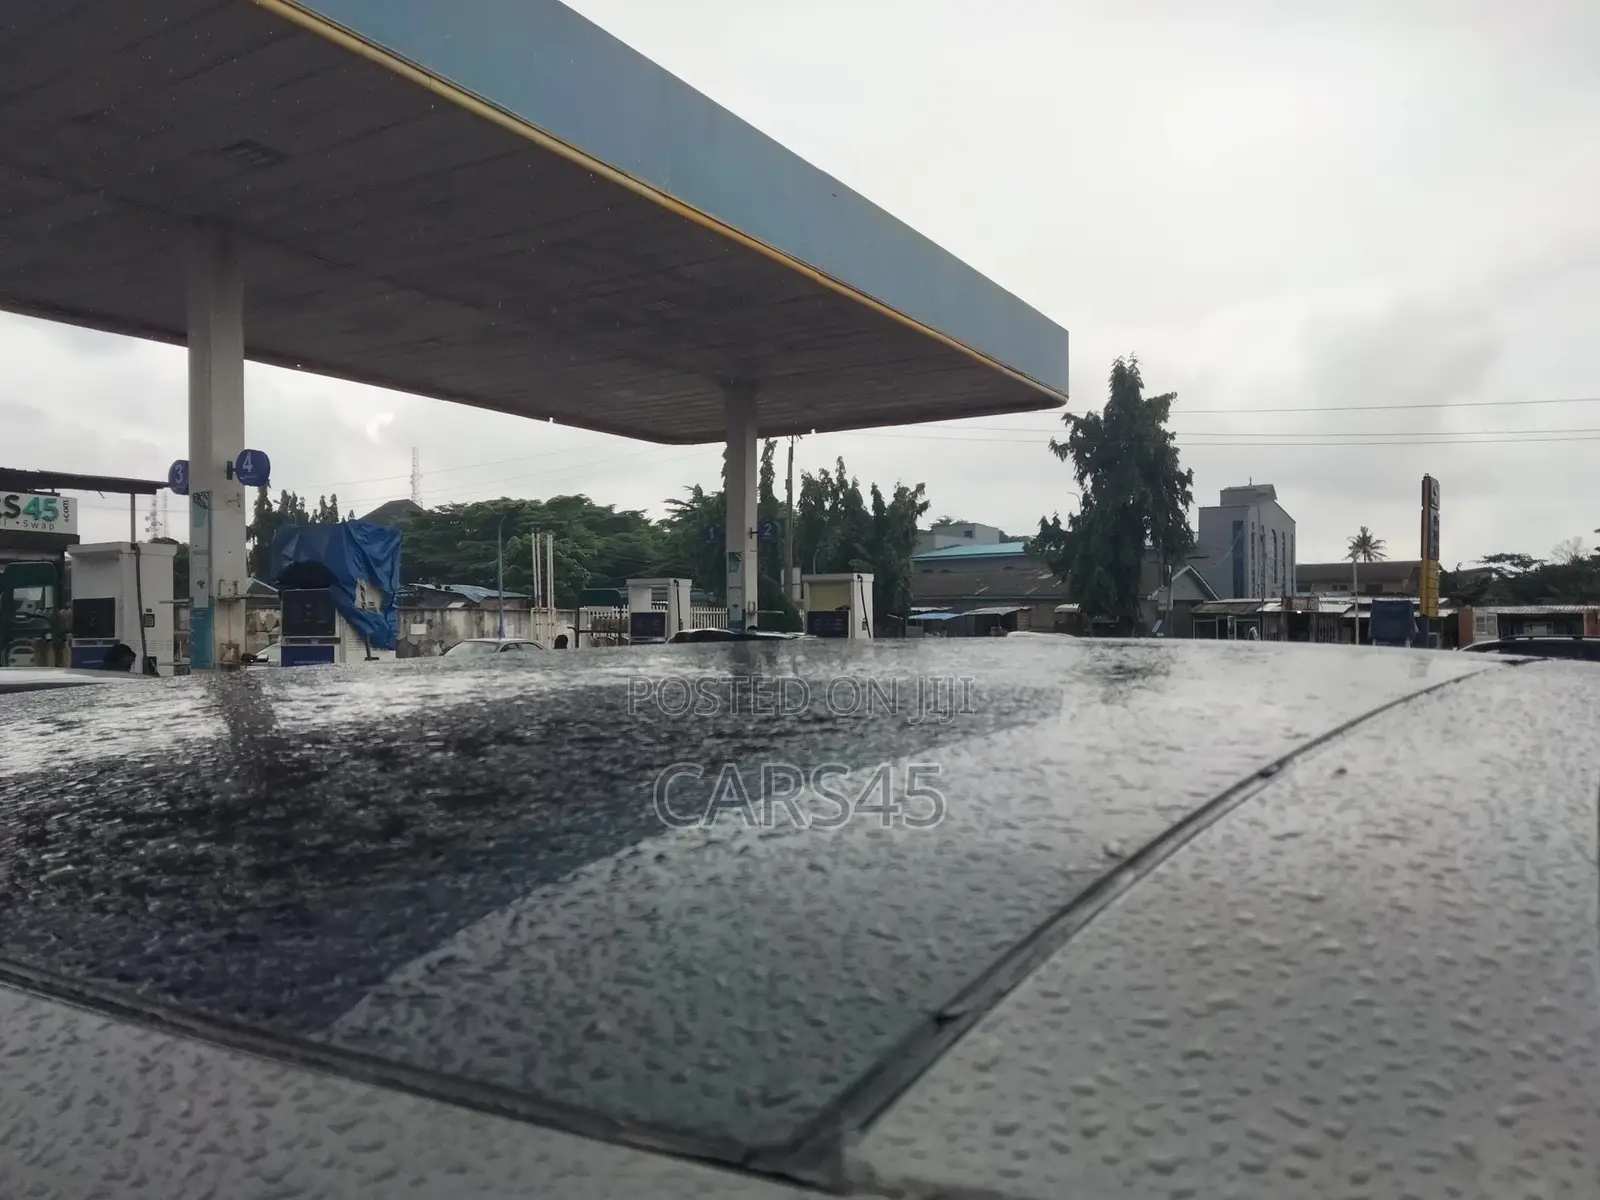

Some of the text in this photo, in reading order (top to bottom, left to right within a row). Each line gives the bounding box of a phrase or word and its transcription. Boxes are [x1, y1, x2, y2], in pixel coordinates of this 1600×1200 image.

[242, 452, 253, 473] 4
[174, 463, 184, 483] 3
[0, 494, 60, 522] S45
[62, 500, 70, 522] .com
[22, 519, 55, 531] Swap
[708, 526, 715, 540] 1
[763, 522, 773, 536] 2
